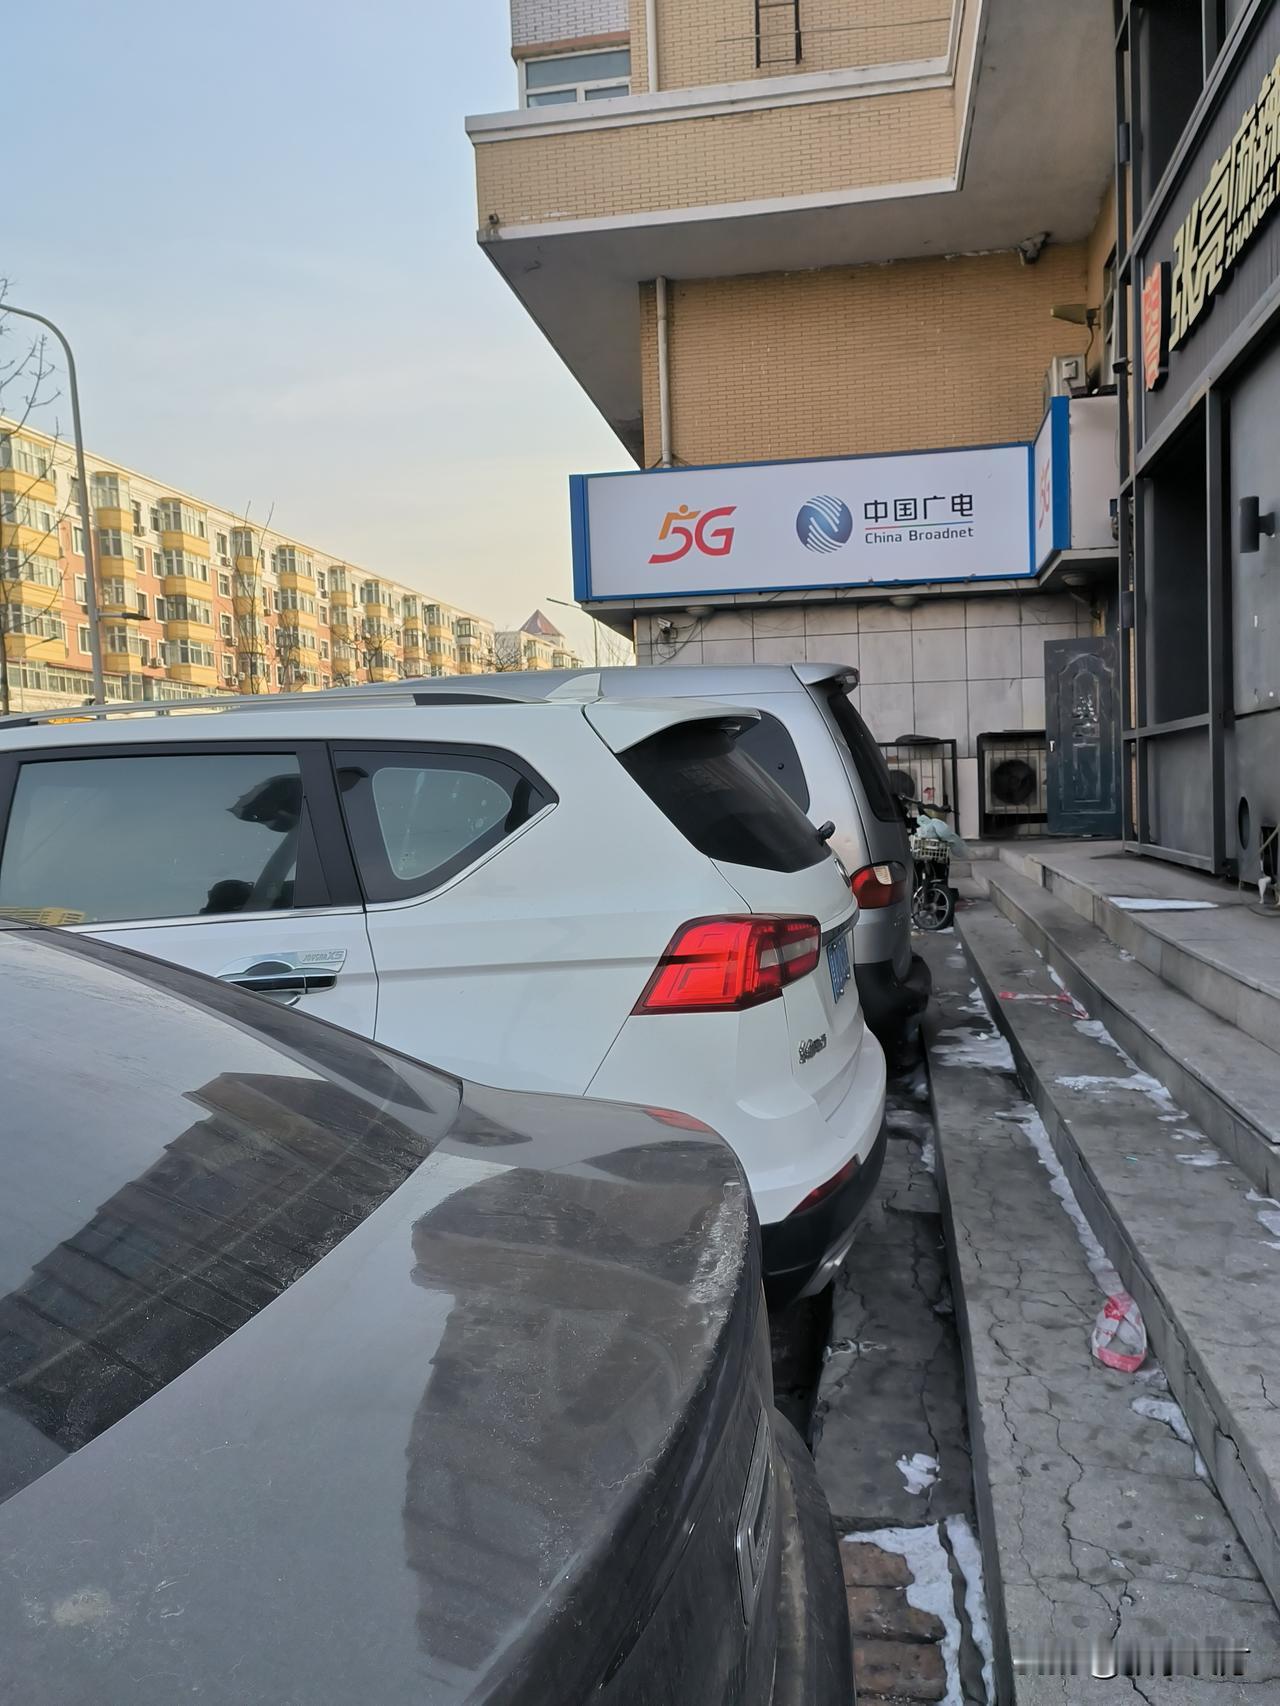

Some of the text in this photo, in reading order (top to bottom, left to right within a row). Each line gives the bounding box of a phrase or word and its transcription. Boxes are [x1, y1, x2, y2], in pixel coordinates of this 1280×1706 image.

[864, 493, 974, 523] 中国广电
[648, 504, 737, 564] 5G
[865, 527, 974, 544] China Broadnet
